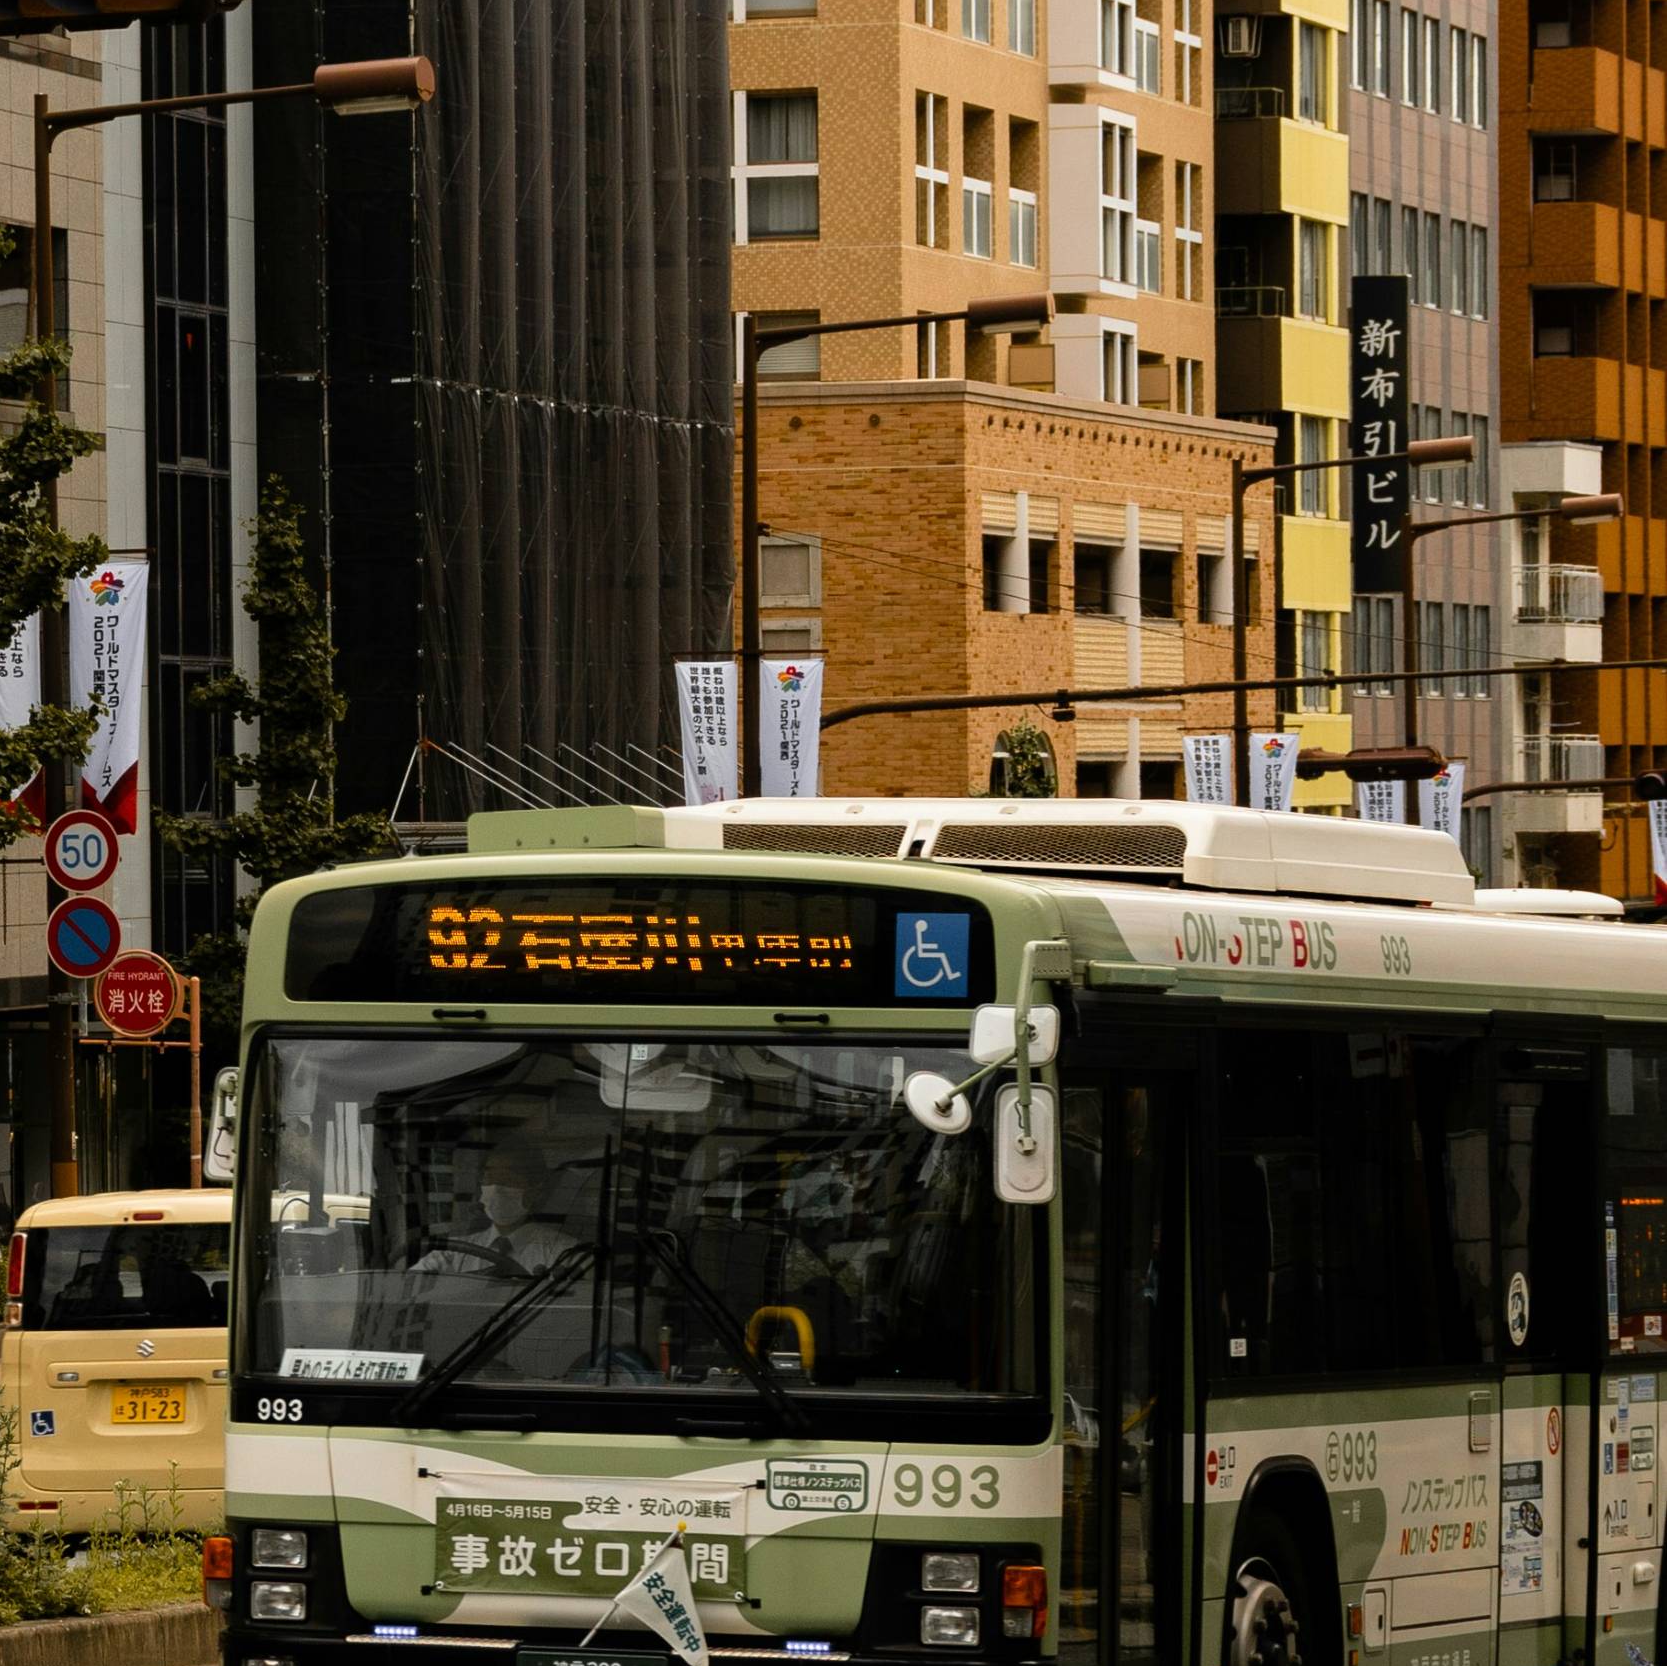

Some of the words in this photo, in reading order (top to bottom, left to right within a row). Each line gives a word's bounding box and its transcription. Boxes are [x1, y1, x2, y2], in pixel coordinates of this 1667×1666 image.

[1358, 318, 1402, 550] 新布引ビル
[61, 833, 103, 869] 50
[1289, 919, 1338, 971] BUS
[1379, 933, 1412, 975] 993
[107, 971, 126, 981] FIRE
[127, 971, 166, 982] HYDRANT
[107, 988, 166, 1015] 消火栓
[127, 1400, 181, 1421] 31-23
[257, 1397, 304, 1422] 993
[1342, 1430, 1378, 1483] 993
[893, 1462, 1001, 1511] 993
[1219, 1475, 1233, 1489] EXIT
[1400, 1474, 1489, 1515] ノンステップバス
[584, 1495, 732, 1520] 安全・安心の運転
[1399, 1522, 1461, 1556] NON-STEP
[1462, 1521, 1488, 1551] BUS
[642, 1571, 702, 1653] 安全運転中
